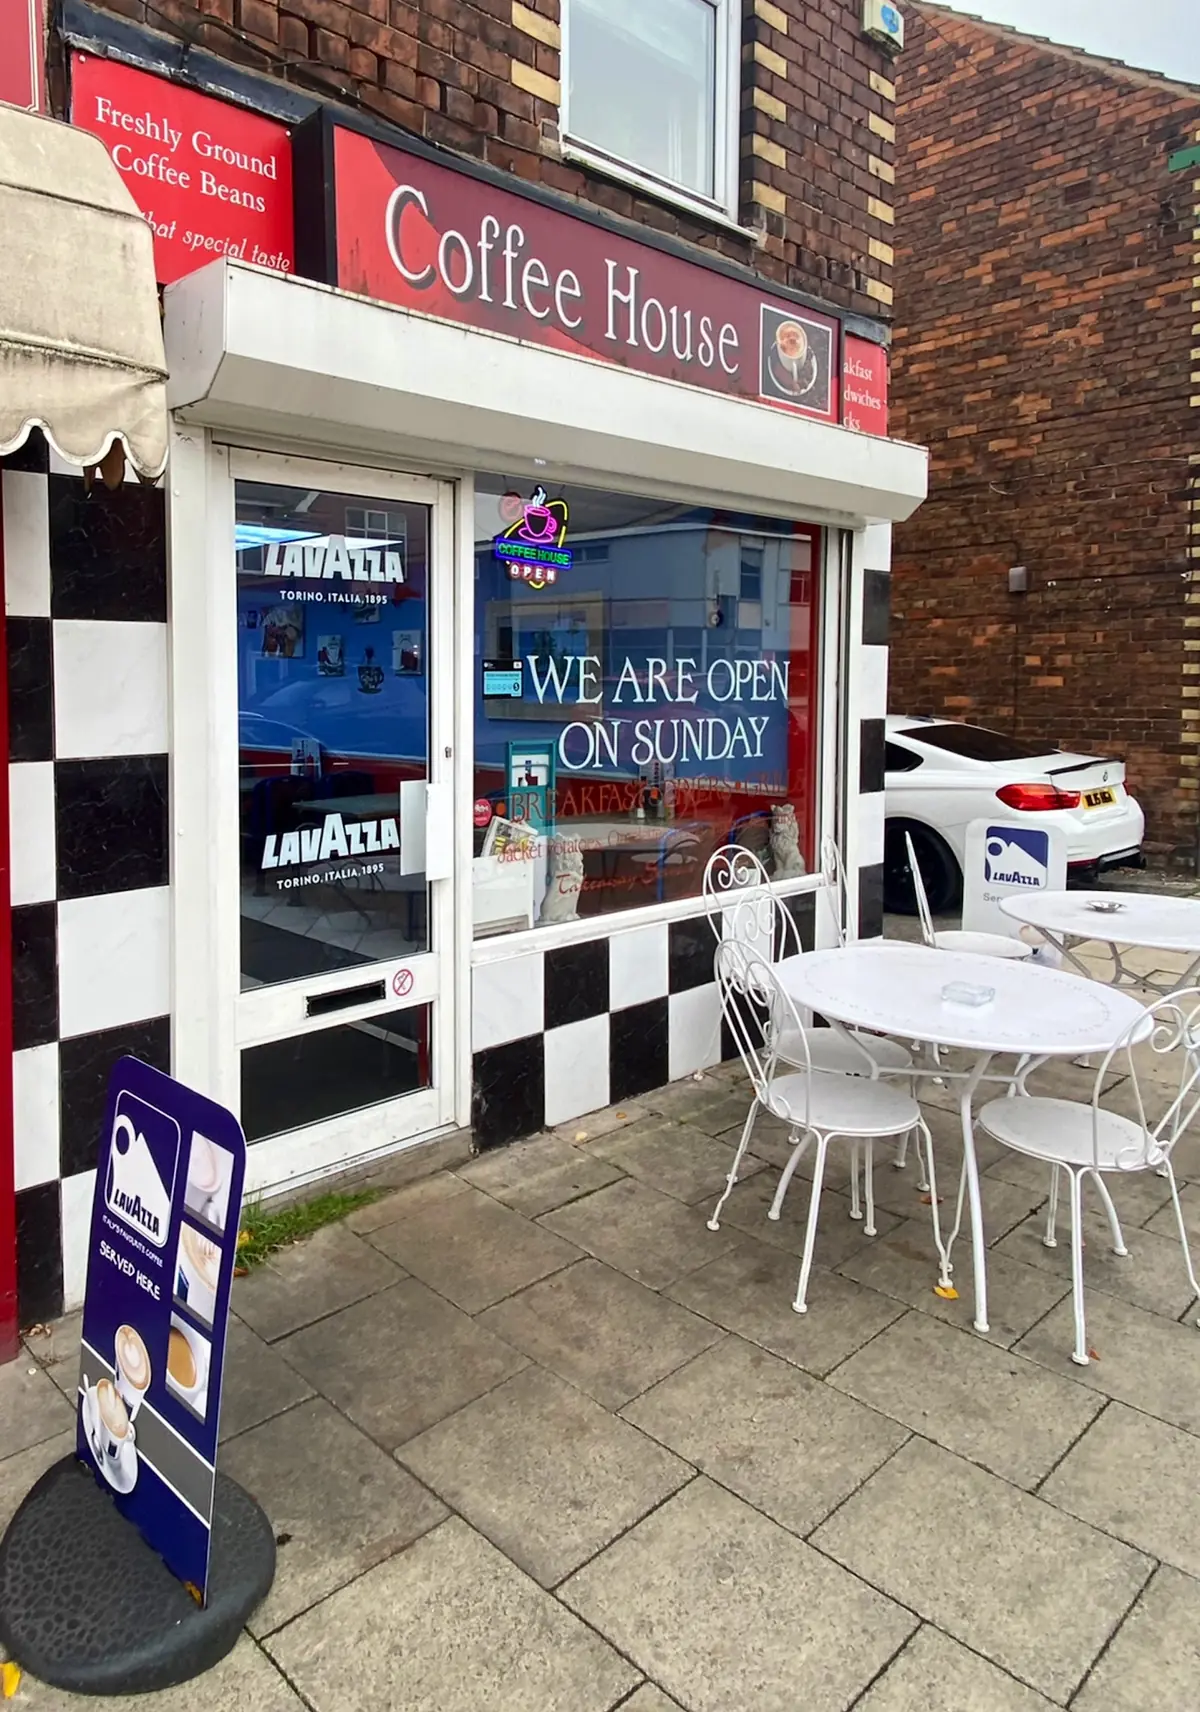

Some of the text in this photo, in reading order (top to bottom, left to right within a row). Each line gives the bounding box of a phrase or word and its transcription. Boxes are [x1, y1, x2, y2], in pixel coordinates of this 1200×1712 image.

[95, 96, 278, 181] Freshly Ground
[111, 144, 266, 214] Coffee Beans
[182, 229, 248, 260] special
[251, 243, 291, 273] taste
[385, 184, 740, 375] Coffee House
[264, 534, 405, 584] LAVAZZA
[498, 542, 570, 566] COFFEE HOUSE
[510, 563, 556, 582] OPEN
[527, 655, 604, 705] WE
[612, 656, 699, 704] ARE
[707, 659, 791, 702] OPEN
[559, 716, 770, 770] ON SUNDAY
[261, 812, 400, 870] LAVAZZA
[993, 871, 1040, 887] LAVAZZA
[113, 1188, 160, 1237] LAVAZZA
[99, 1239, 161, 1301] SERVED HERE
